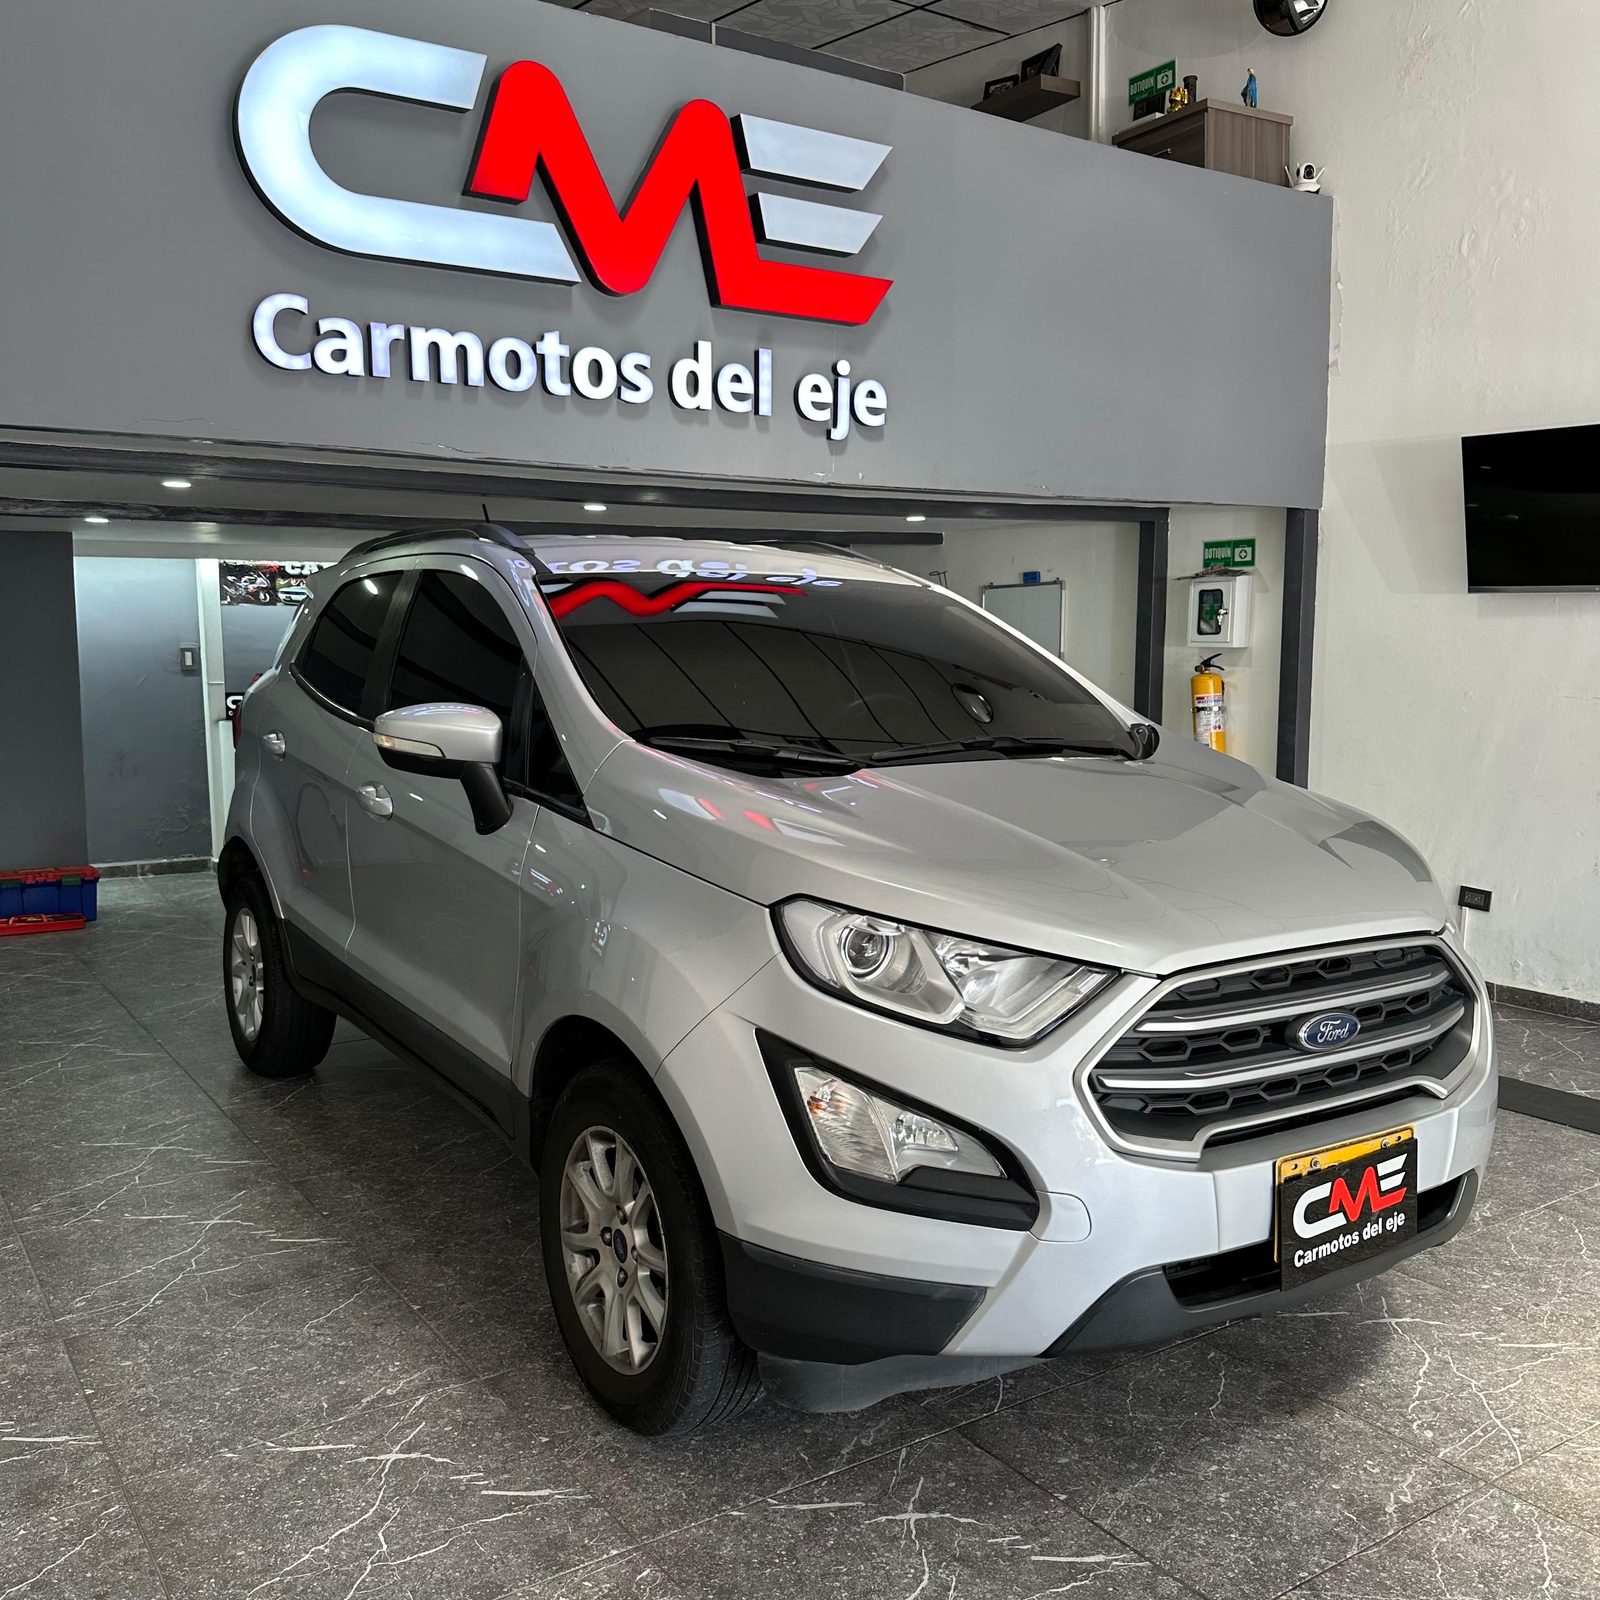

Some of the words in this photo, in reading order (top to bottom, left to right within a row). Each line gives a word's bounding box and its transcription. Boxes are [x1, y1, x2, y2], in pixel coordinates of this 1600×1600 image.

[233, 24, 893, 325] CME
[251, 293, 653, 404] Carmotos
[669, 340, 772, 417] del
[795, 359, 887, 441] eje
[1317, 1019, 1349, 1043] Ford
[1293, 1153, 1407, 1239] CME
[1294, 1231, 1359, 1267] Carmotos
[1362, 1217, 1382, 1240] del
[1385, 1211, 1405, 1232] eje
